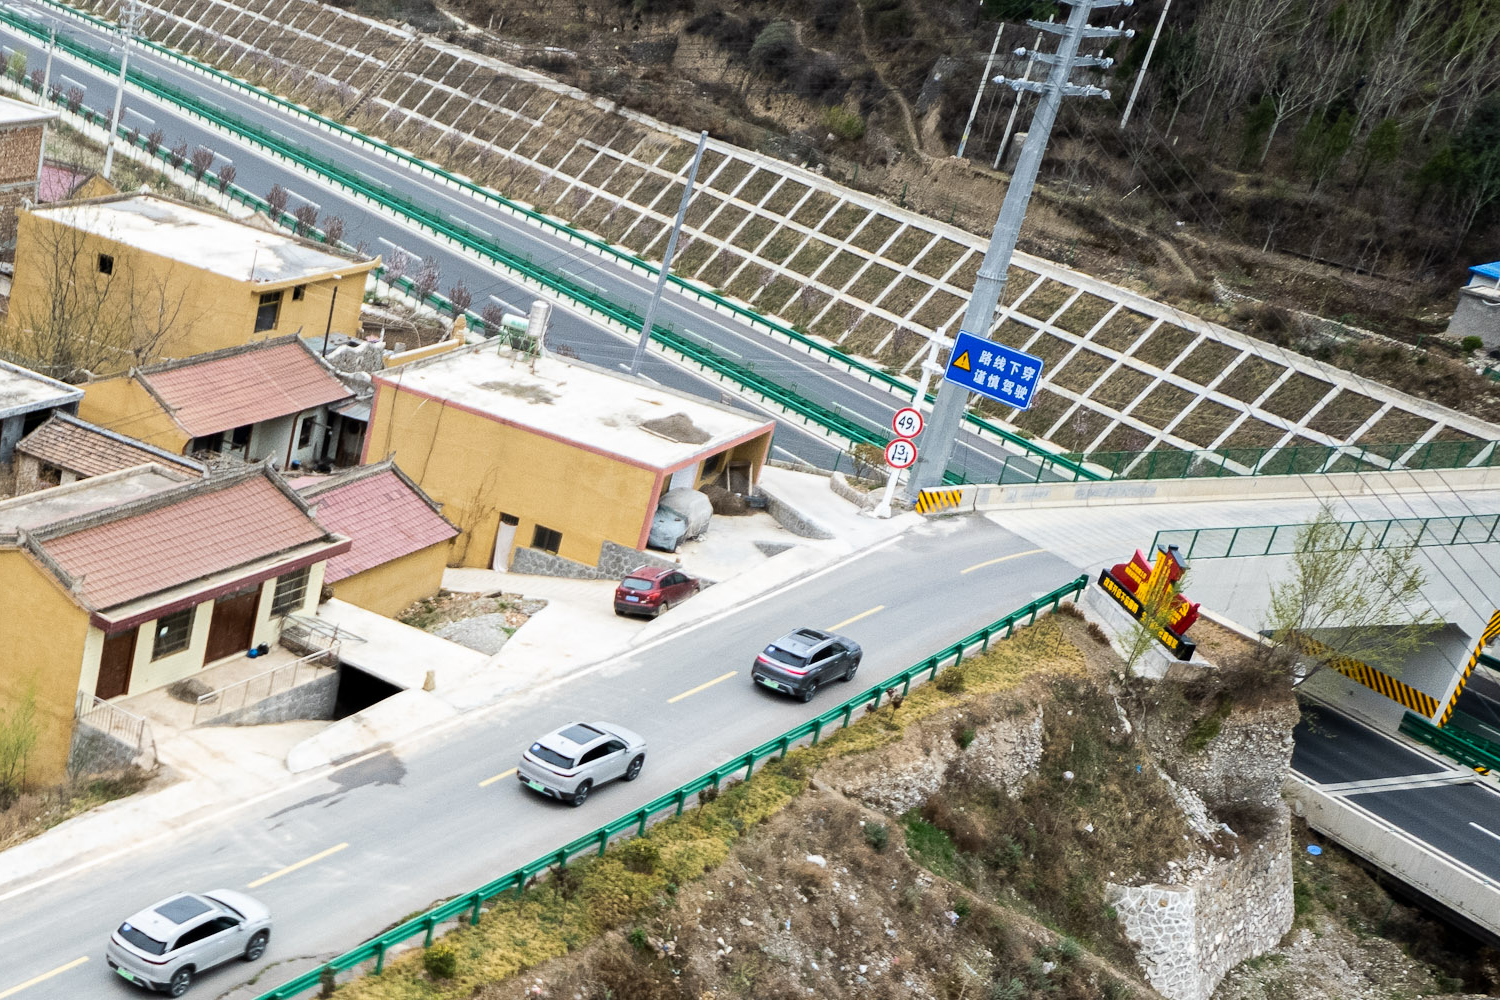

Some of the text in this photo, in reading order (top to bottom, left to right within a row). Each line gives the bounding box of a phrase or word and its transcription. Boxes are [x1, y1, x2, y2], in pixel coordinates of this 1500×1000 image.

[978, 350, 1036, 381] 路线下穿
[973, 369, 1028, 401] 谨慎驾驶
